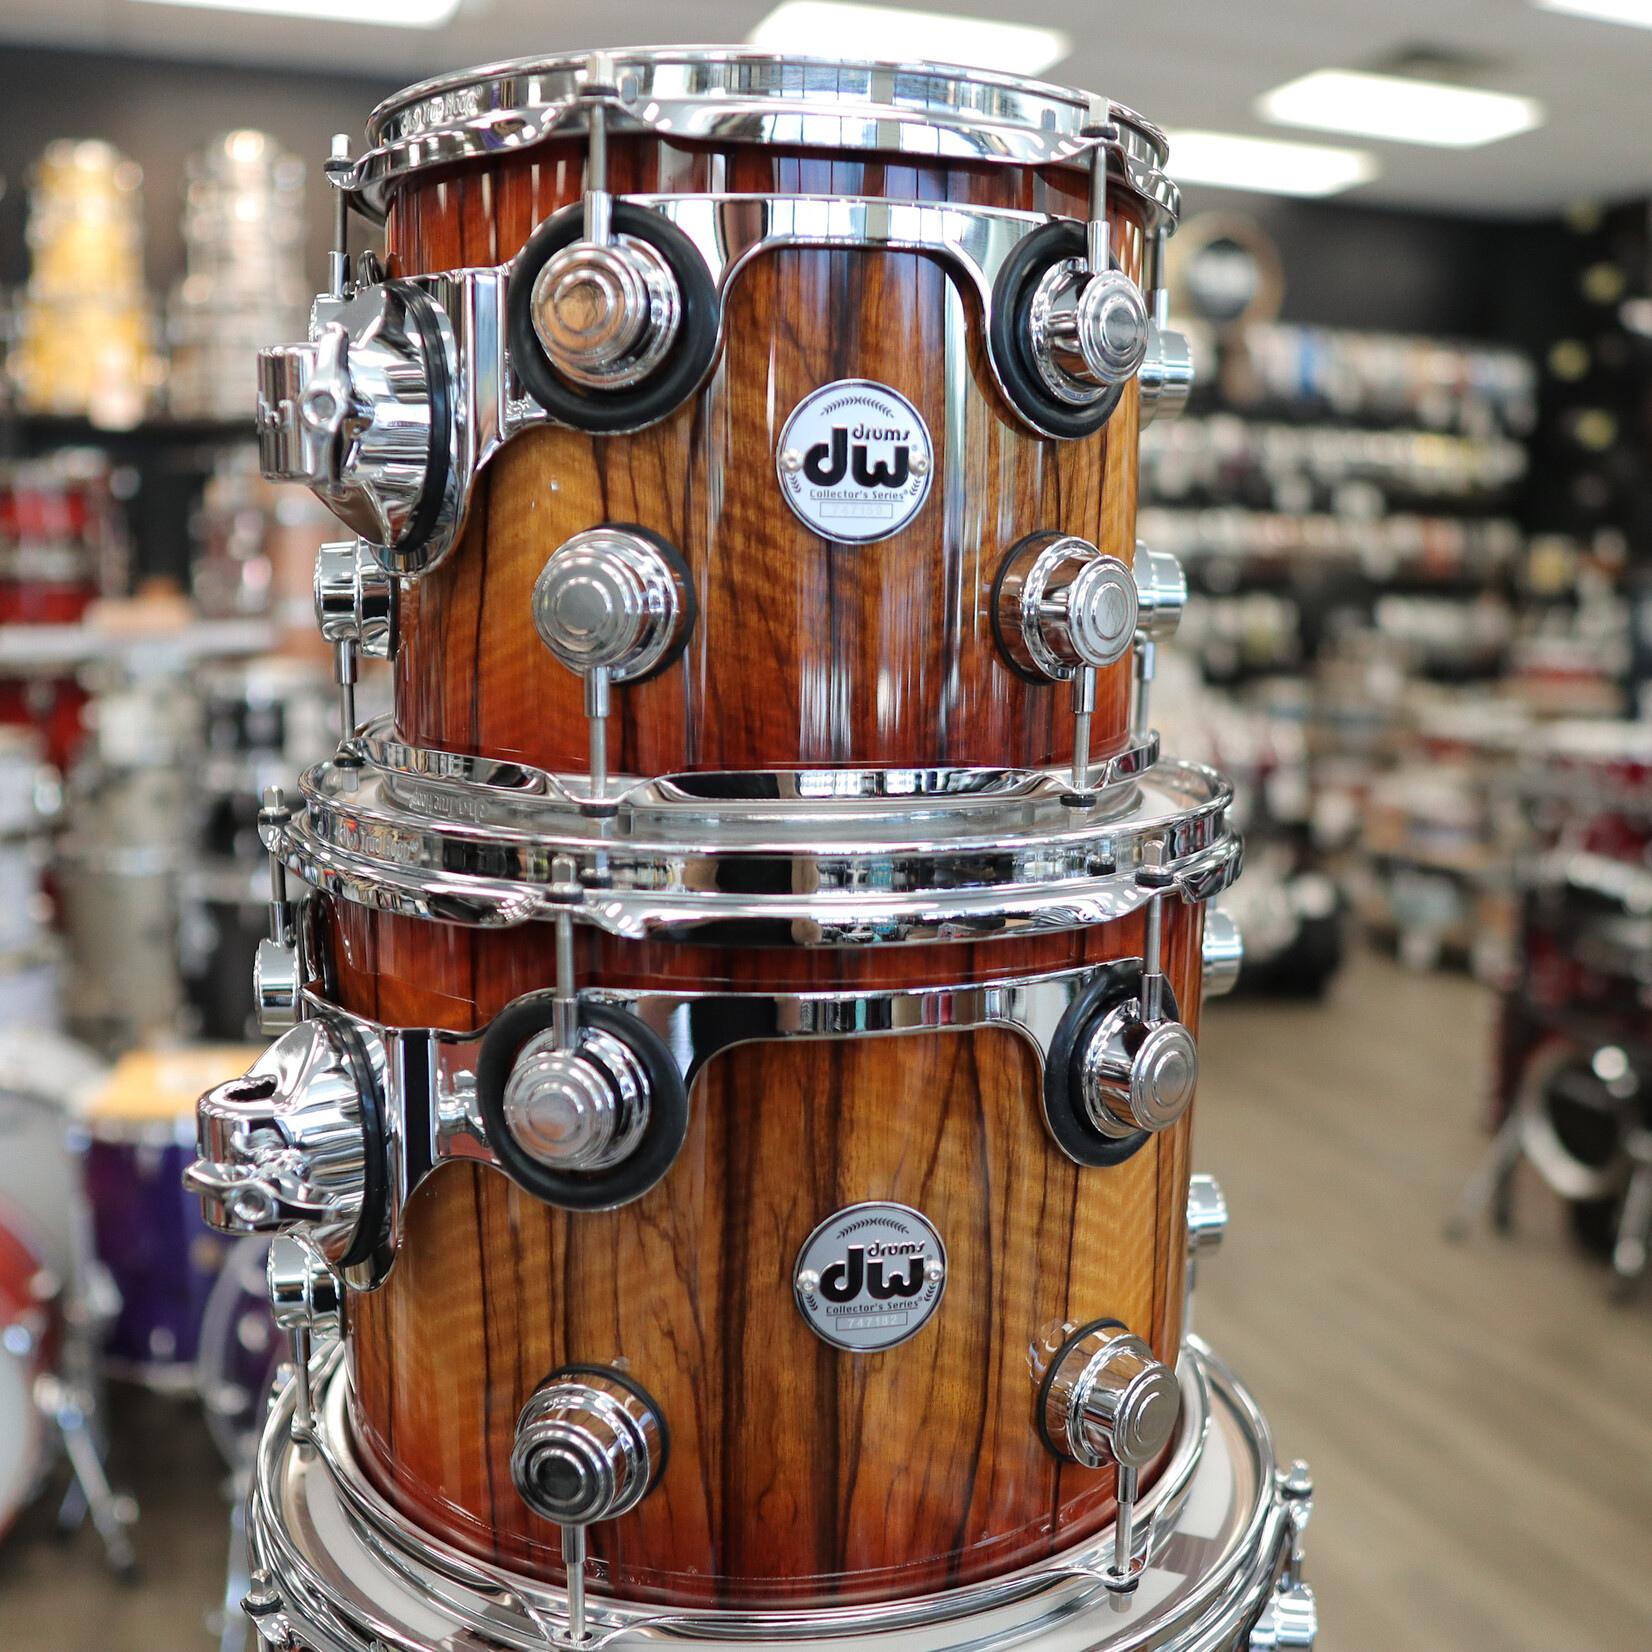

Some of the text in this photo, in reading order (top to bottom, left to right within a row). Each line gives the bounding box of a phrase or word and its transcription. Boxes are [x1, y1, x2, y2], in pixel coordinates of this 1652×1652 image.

[852, 422, 910, 441] drums
[803, 424, 909, 487] dw
[810, 489, 868, 499] Collector's
[867, 1239, 926, 1257] drums
[819, 1245, 924, 1303] dw
[826, 1303, 883, 1314] Collector's
